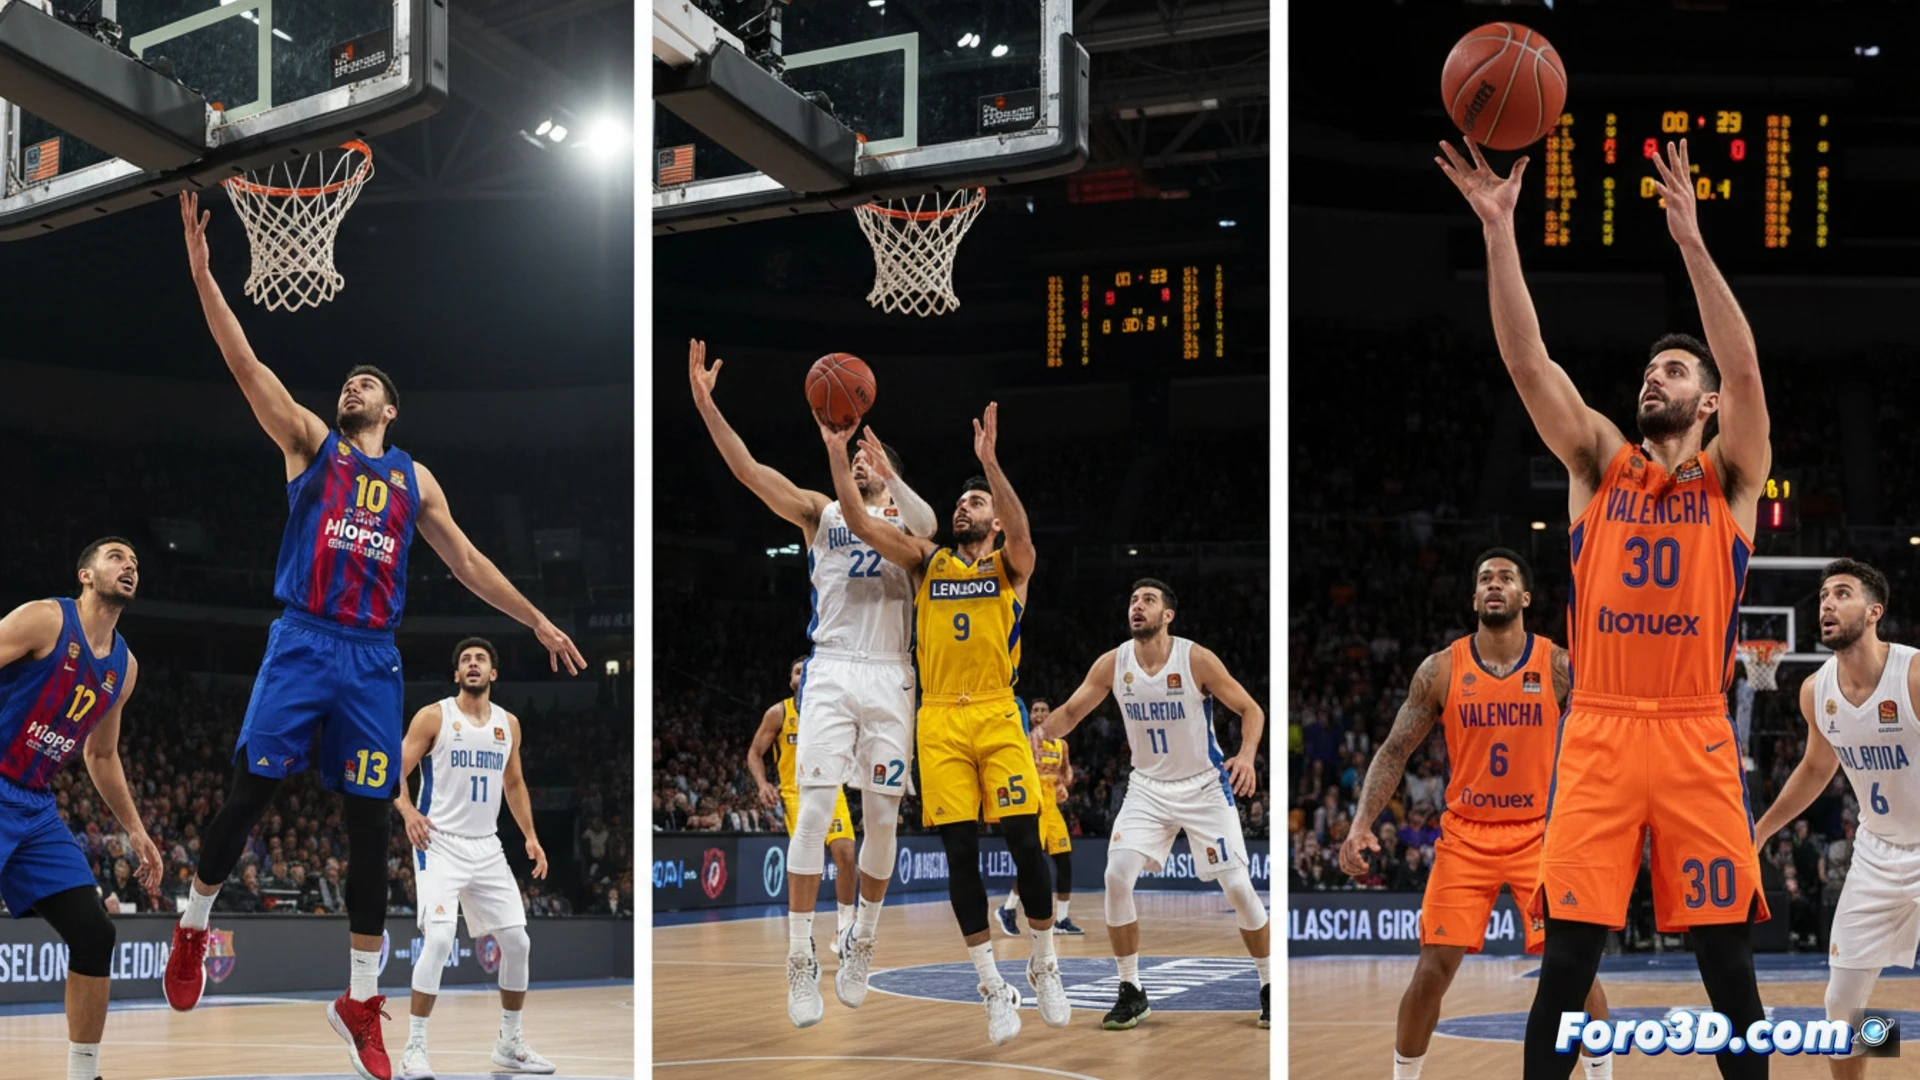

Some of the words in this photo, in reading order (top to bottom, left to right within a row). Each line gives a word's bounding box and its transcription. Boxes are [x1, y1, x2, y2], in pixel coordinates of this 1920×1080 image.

[356, 474, 388, 513] 10
[848, 549, 882, 578] 22
[1622, 537, 1680, 588] 30
[953, 612, 970, 642] 9
[1146, 728, 1169, 754] 11
[356, 749, 388, 788] 13
[886, 759, 905, 787] 2
[1489, 742, 1509, 778] 6
[470, 775, 488, 803] 11
[1008, 774, 1027, 805] 5
[1870, 781, 1890, 815] 6
[1216, 836, 1228, 862] 1
[1682, 857, 1736, 909] 30
